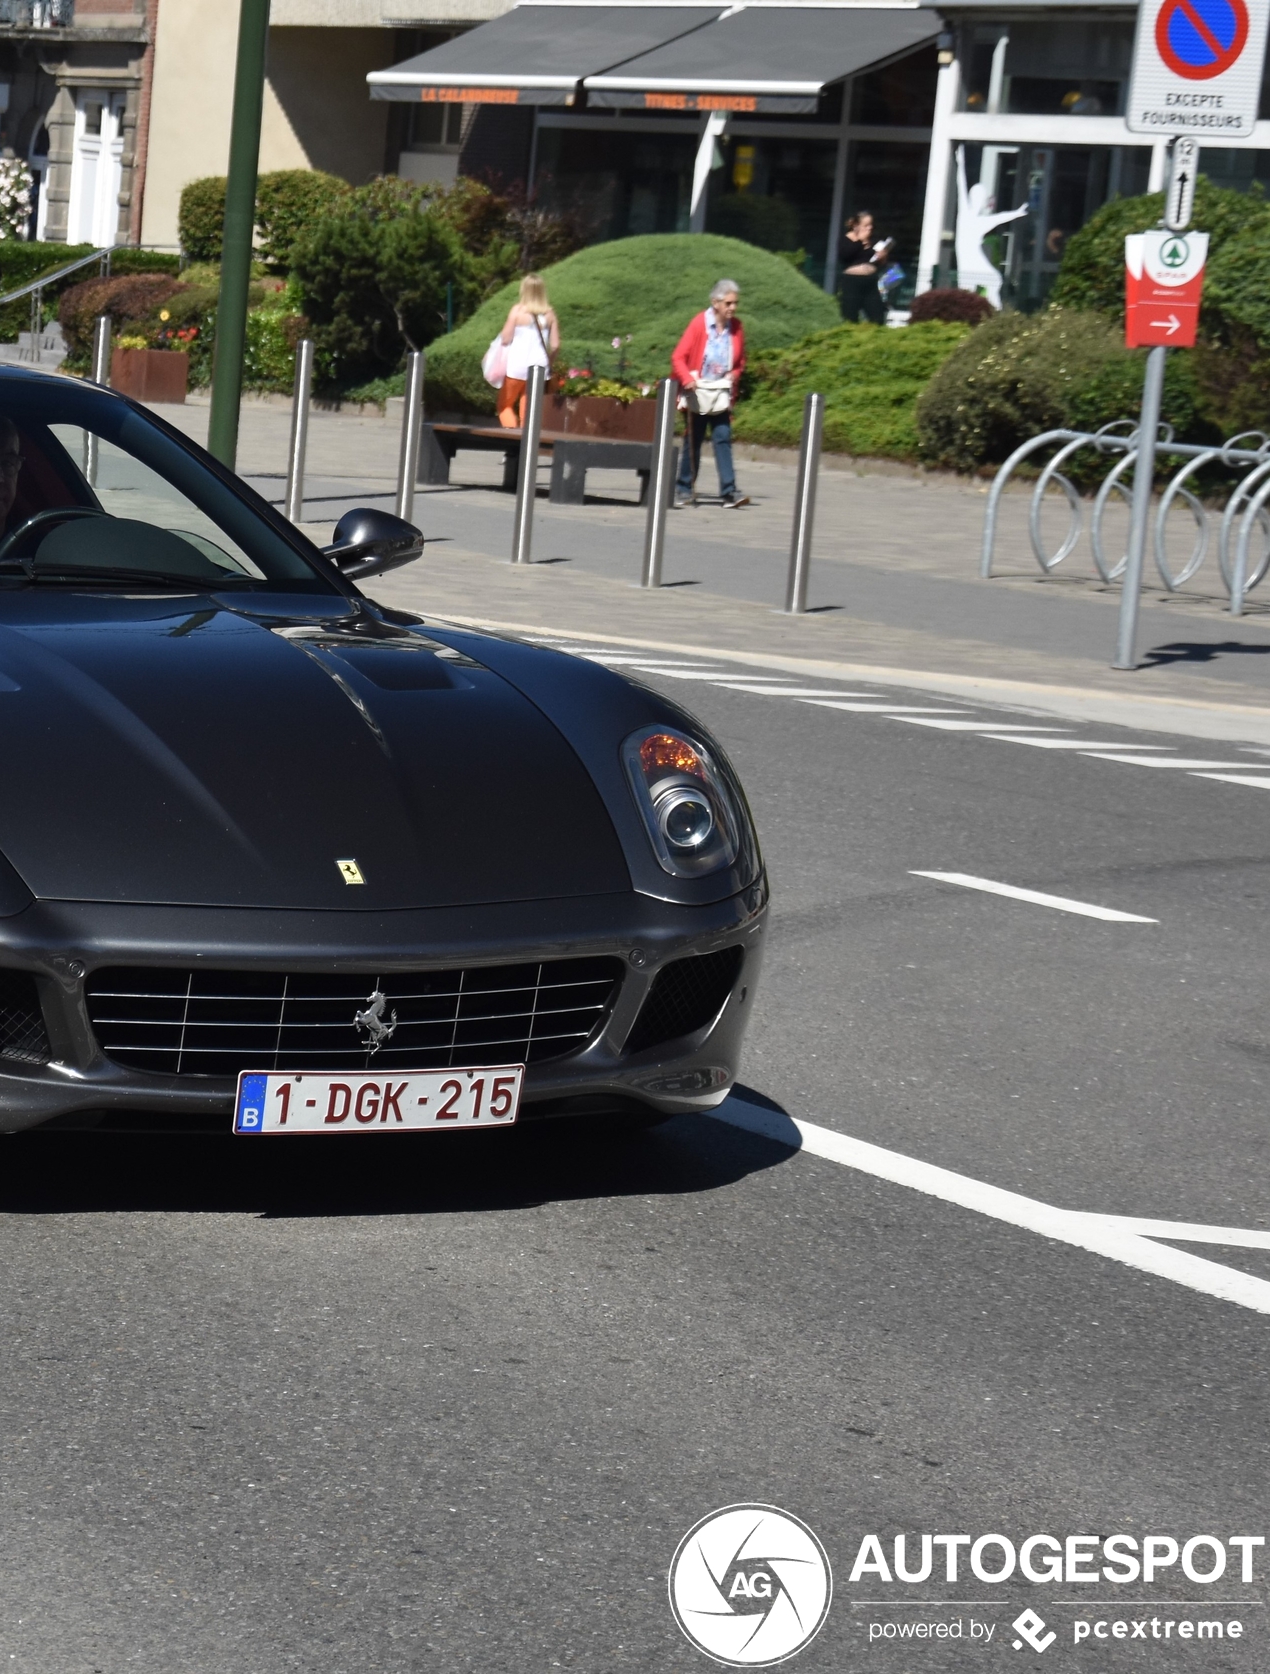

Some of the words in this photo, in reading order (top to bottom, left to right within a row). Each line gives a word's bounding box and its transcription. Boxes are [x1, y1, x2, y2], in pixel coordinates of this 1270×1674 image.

[1165, 92, 1224, 109] EXCEPTE
[1141, 111, 1243, 129] FOURNISSEURS
[241, 1107, 259, 1128] B
